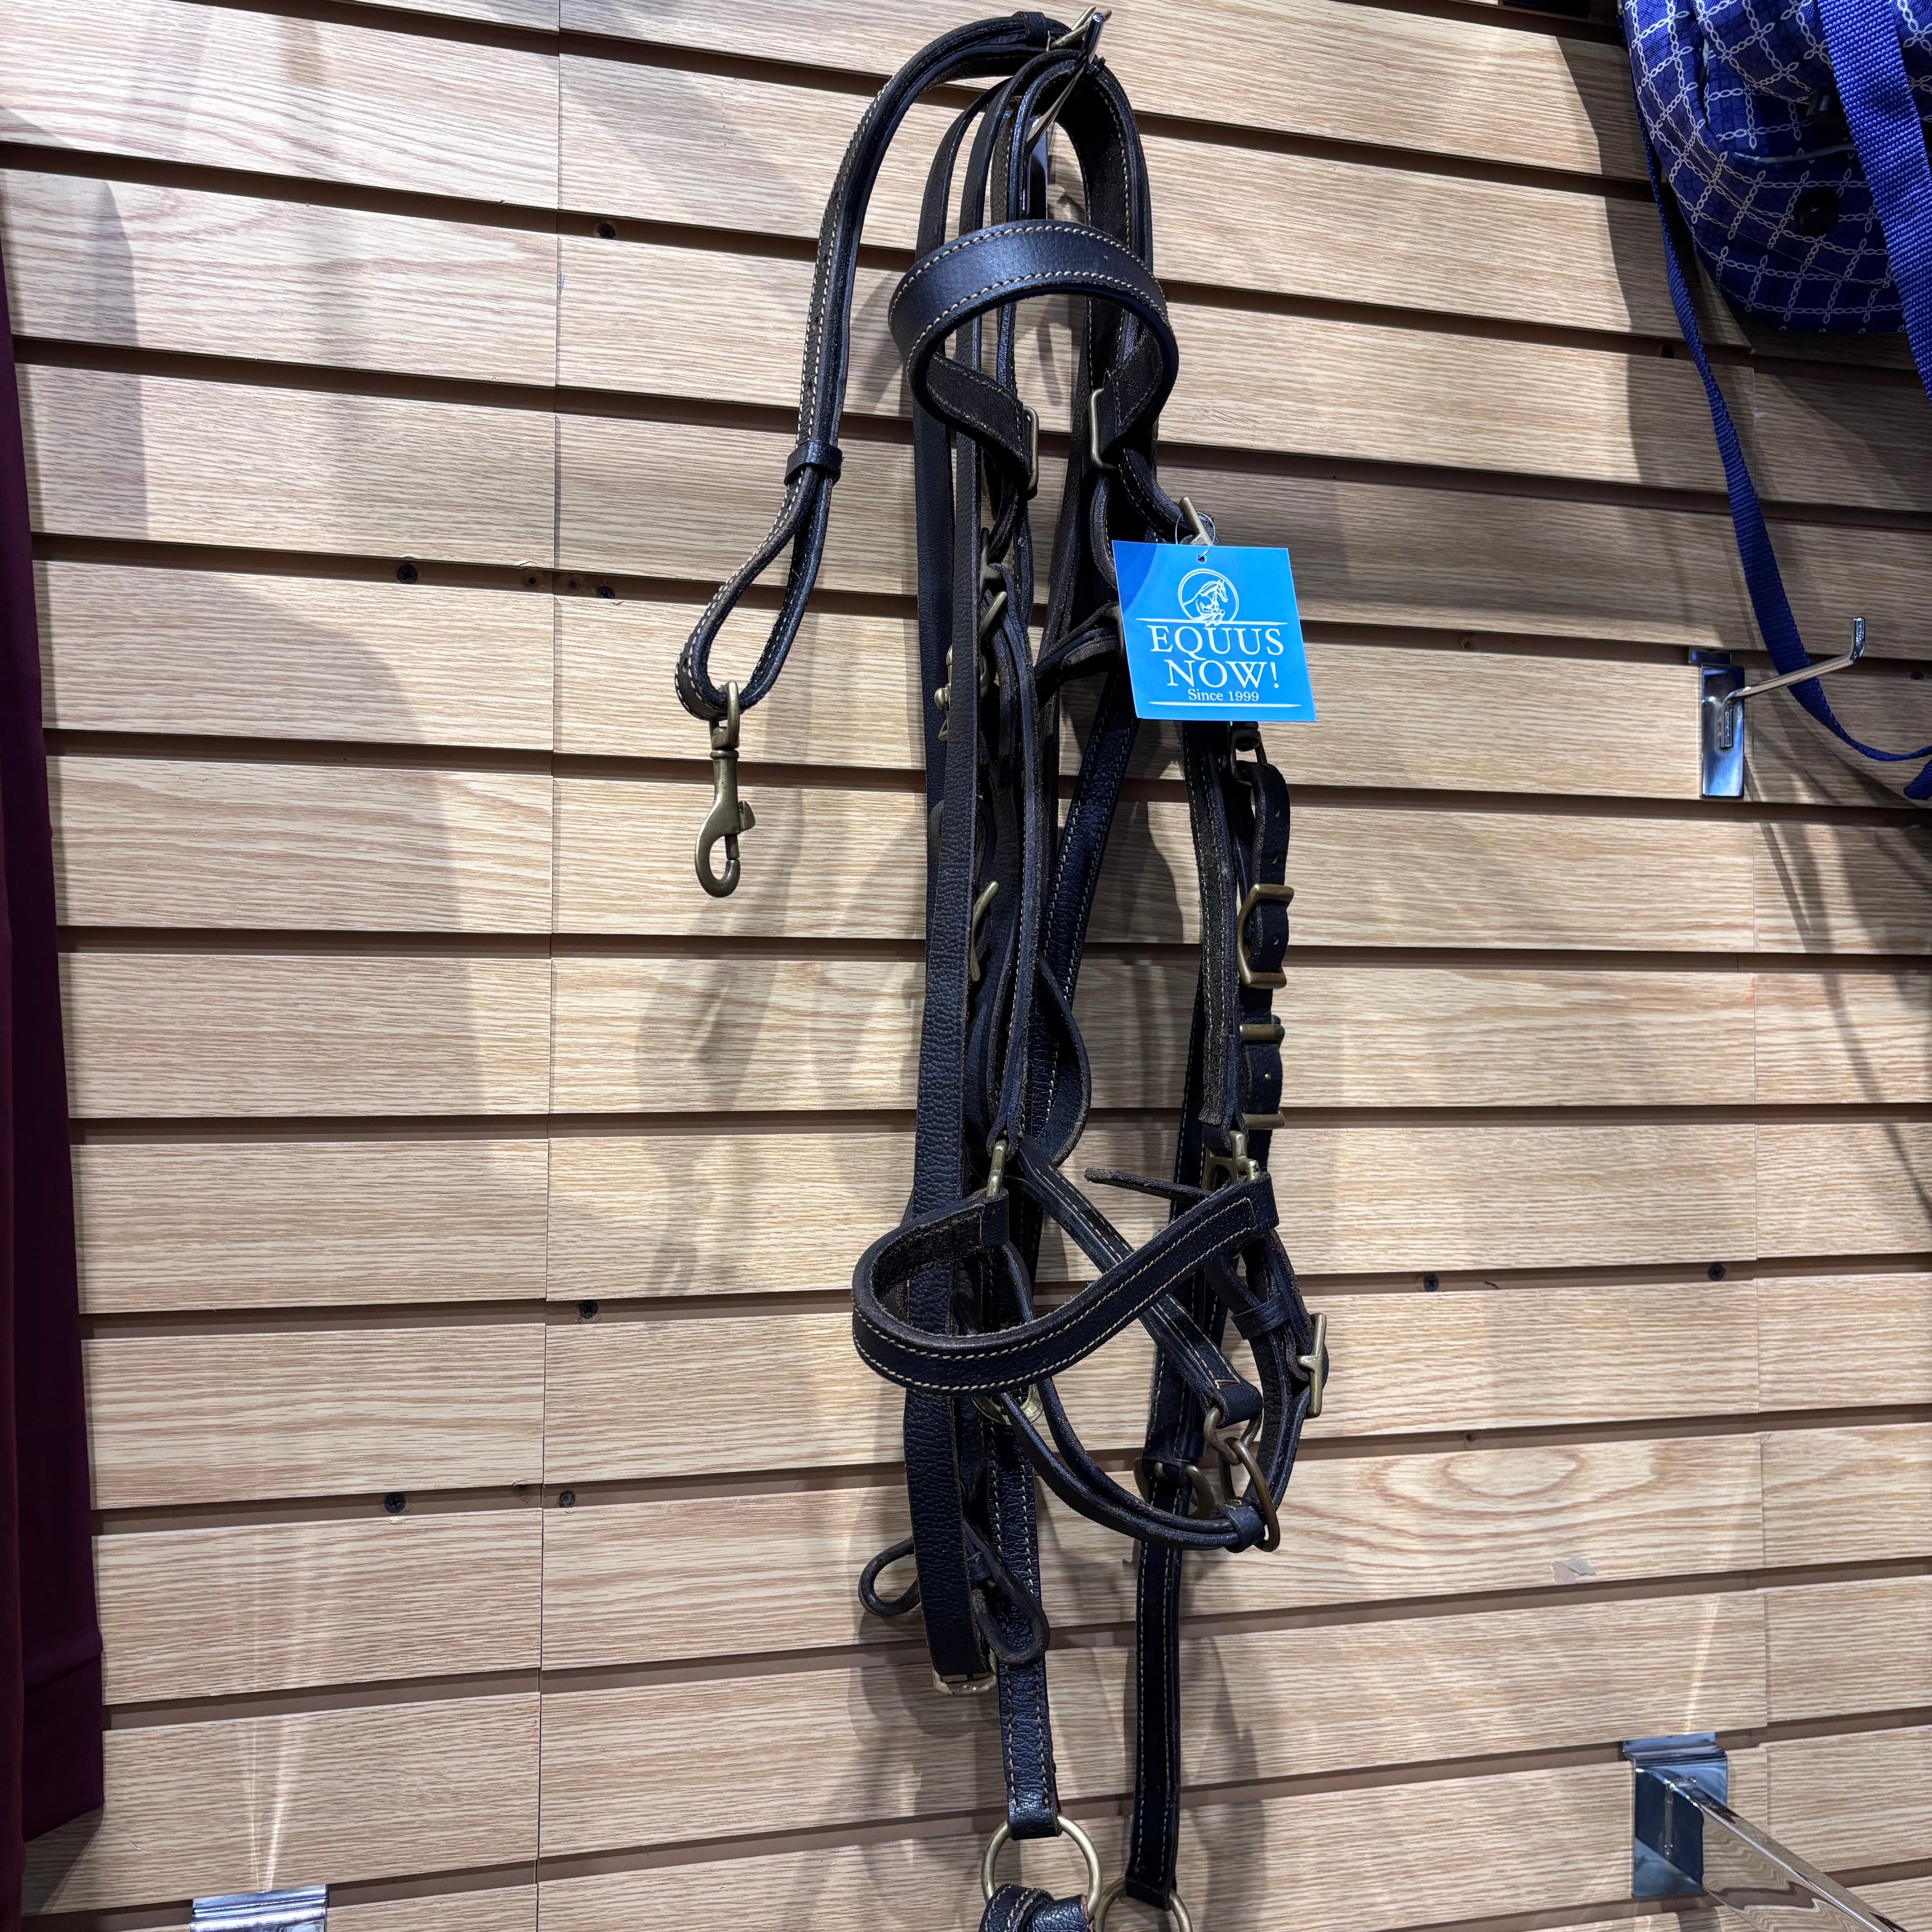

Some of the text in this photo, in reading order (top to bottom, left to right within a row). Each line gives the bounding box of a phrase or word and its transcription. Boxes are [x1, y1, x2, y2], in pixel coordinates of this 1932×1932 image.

[1147, 625, 1283, 660] EQUUS
[1164, 659, 1279, 688] NOW!
[1188, 689, 1259, 701] Since 1999
